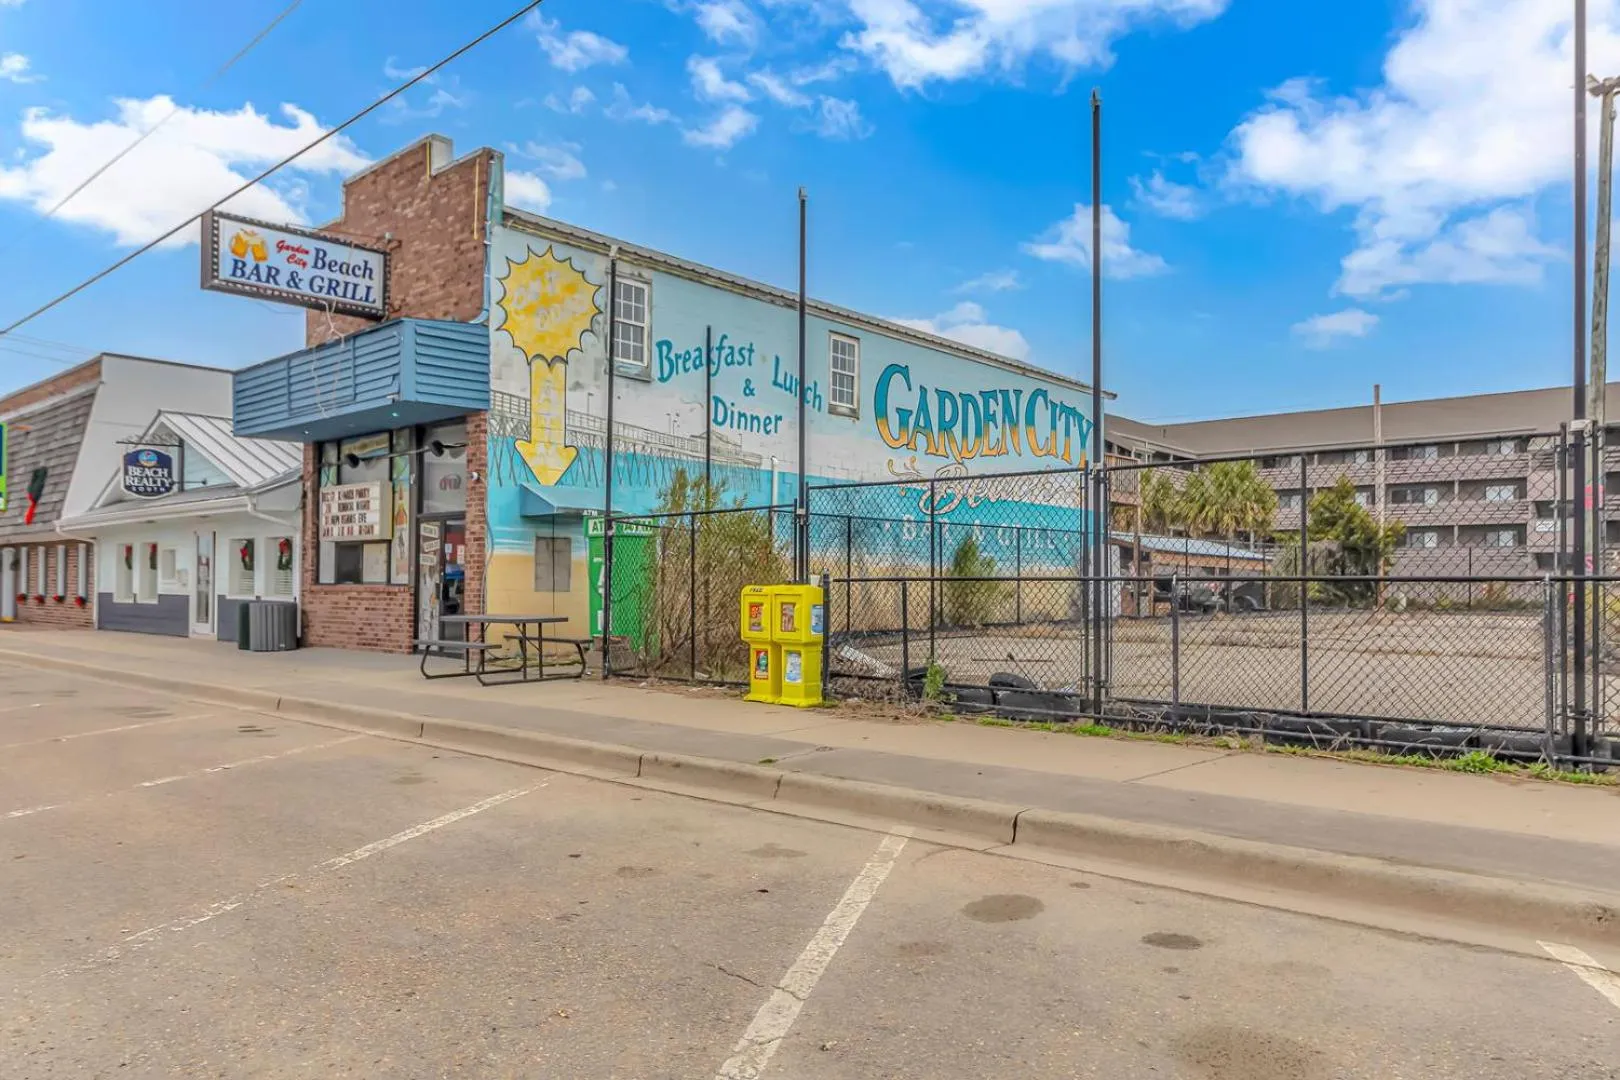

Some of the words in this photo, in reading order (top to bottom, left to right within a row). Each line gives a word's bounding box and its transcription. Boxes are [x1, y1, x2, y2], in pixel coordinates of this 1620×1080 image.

[275, 240, 310, 256] Garden
[286, 254, 309, 269] City
[311, 247, 374, 280] Beach
[229, 258, 281, 286] BAR
[286, 270, 304, 290] &
[309, 275, 377, 304] GRILL
[743, 378, 756, 397] &
[712, 395, 784, 435] Dinner
[127, 465, 169, 477] BEACH
[125, 475, 171, 487] REALTY
[358, 513, 367, 523] EVE
[583, 509, 598, 517] ATM
[591, 519, 609, 534] AT
